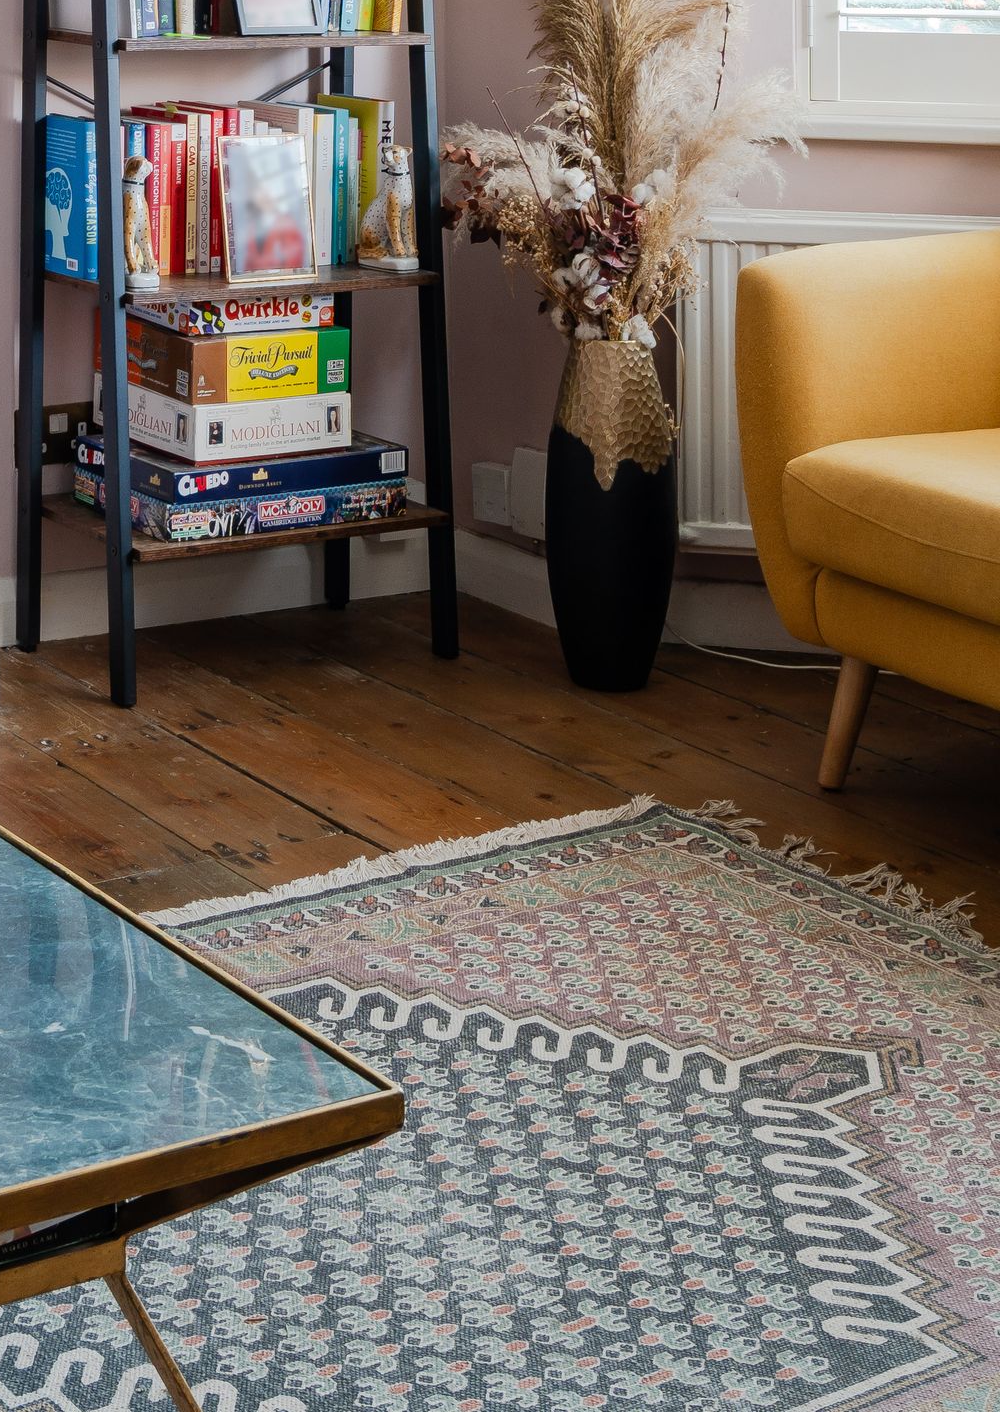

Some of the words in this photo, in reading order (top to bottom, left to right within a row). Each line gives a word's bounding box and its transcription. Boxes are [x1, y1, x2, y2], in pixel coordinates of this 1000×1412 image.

[188, 123, 196, 142] THE
[229, 118, 237, 137] LEN
[153, 129, 161, 162] PATRICK
[88, 158, 97, 173] The
[84, 174, 97, 194] Edge
[84, 194, 97, 205] of
[86, 206, 97, 245] REASON
[200, 189, 208, 256] PSYCHOLOGY
[224, 296, 299, 321] Qwirkle
[229, 346, 272, 368] Trivial
[265, 342, 313, 369] Pursuit
[251, 367, 272, 378] DELUXE
[272, 366, 295, 378] EDITION
[128, 409, 172, 435] DIGLIANI
[231, 420, 321, 442] MODIGLIANI
[248, 441, 261, 449] family
[178, 471, 229, 497] CLUEDO
[262, 518, 297, 528] CAMBRIDGE
[297, 514, 323, 524] EDITION
[1, 1241, 29, 1253] WORD
